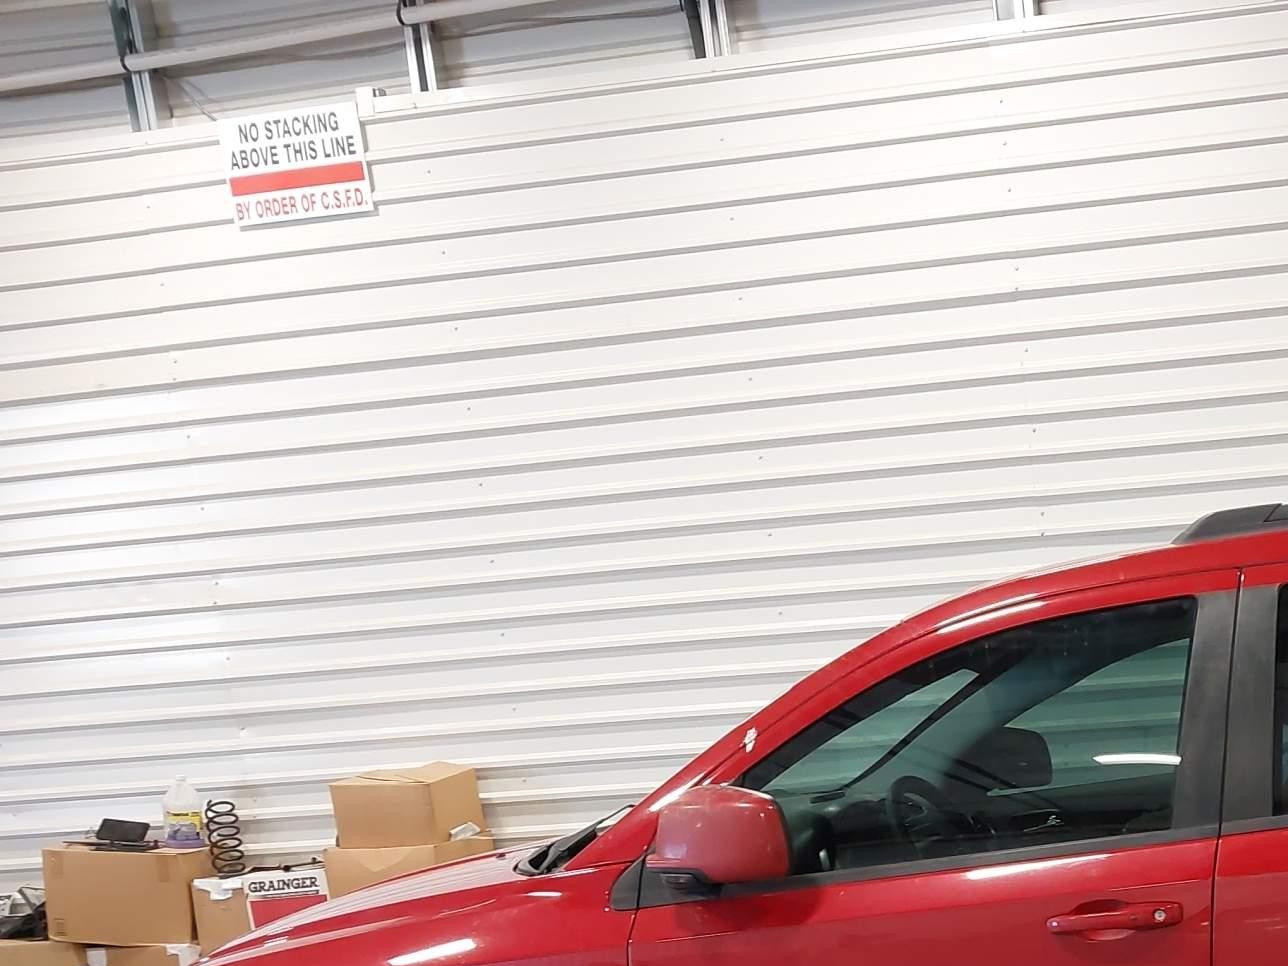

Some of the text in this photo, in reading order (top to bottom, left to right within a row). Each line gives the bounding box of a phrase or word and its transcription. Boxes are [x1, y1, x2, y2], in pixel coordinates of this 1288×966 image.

[238, 112, 339, 144] NO STACKING
[231, 135, 357, 170] ABOVE THIS LINE
[236, 188, 368, 221] BY ORDER OF C.S.F.D.
[248, 876, 320, 893] GRAINGER
